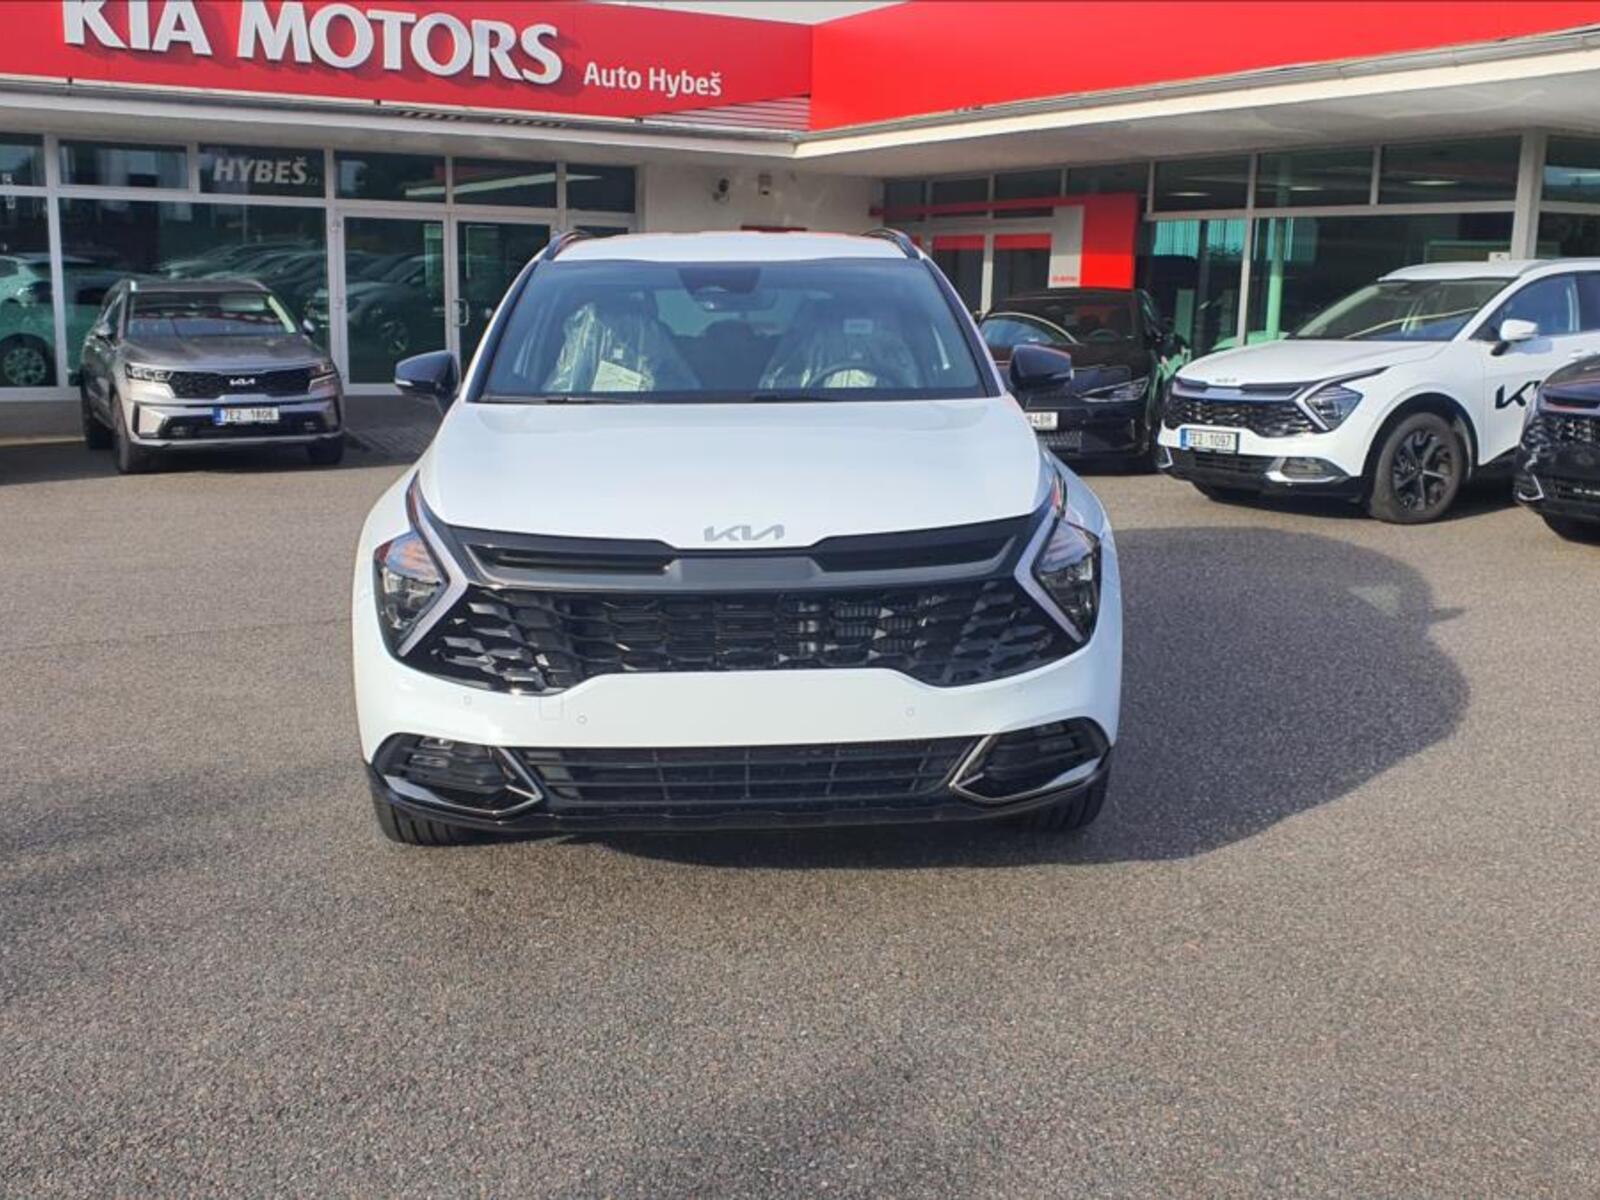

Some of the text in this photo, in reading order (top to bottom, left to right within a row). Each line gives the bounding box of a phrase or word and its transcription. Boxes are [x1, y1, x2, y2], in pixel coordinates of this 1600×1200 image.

[62, 0, 563, 85] KIA MOTORS
[584, 62, 721, 98] Auto Hybeš
[213, 157, 308, 185] HYBEŠ
[704, 523, 785, 542] KIA
